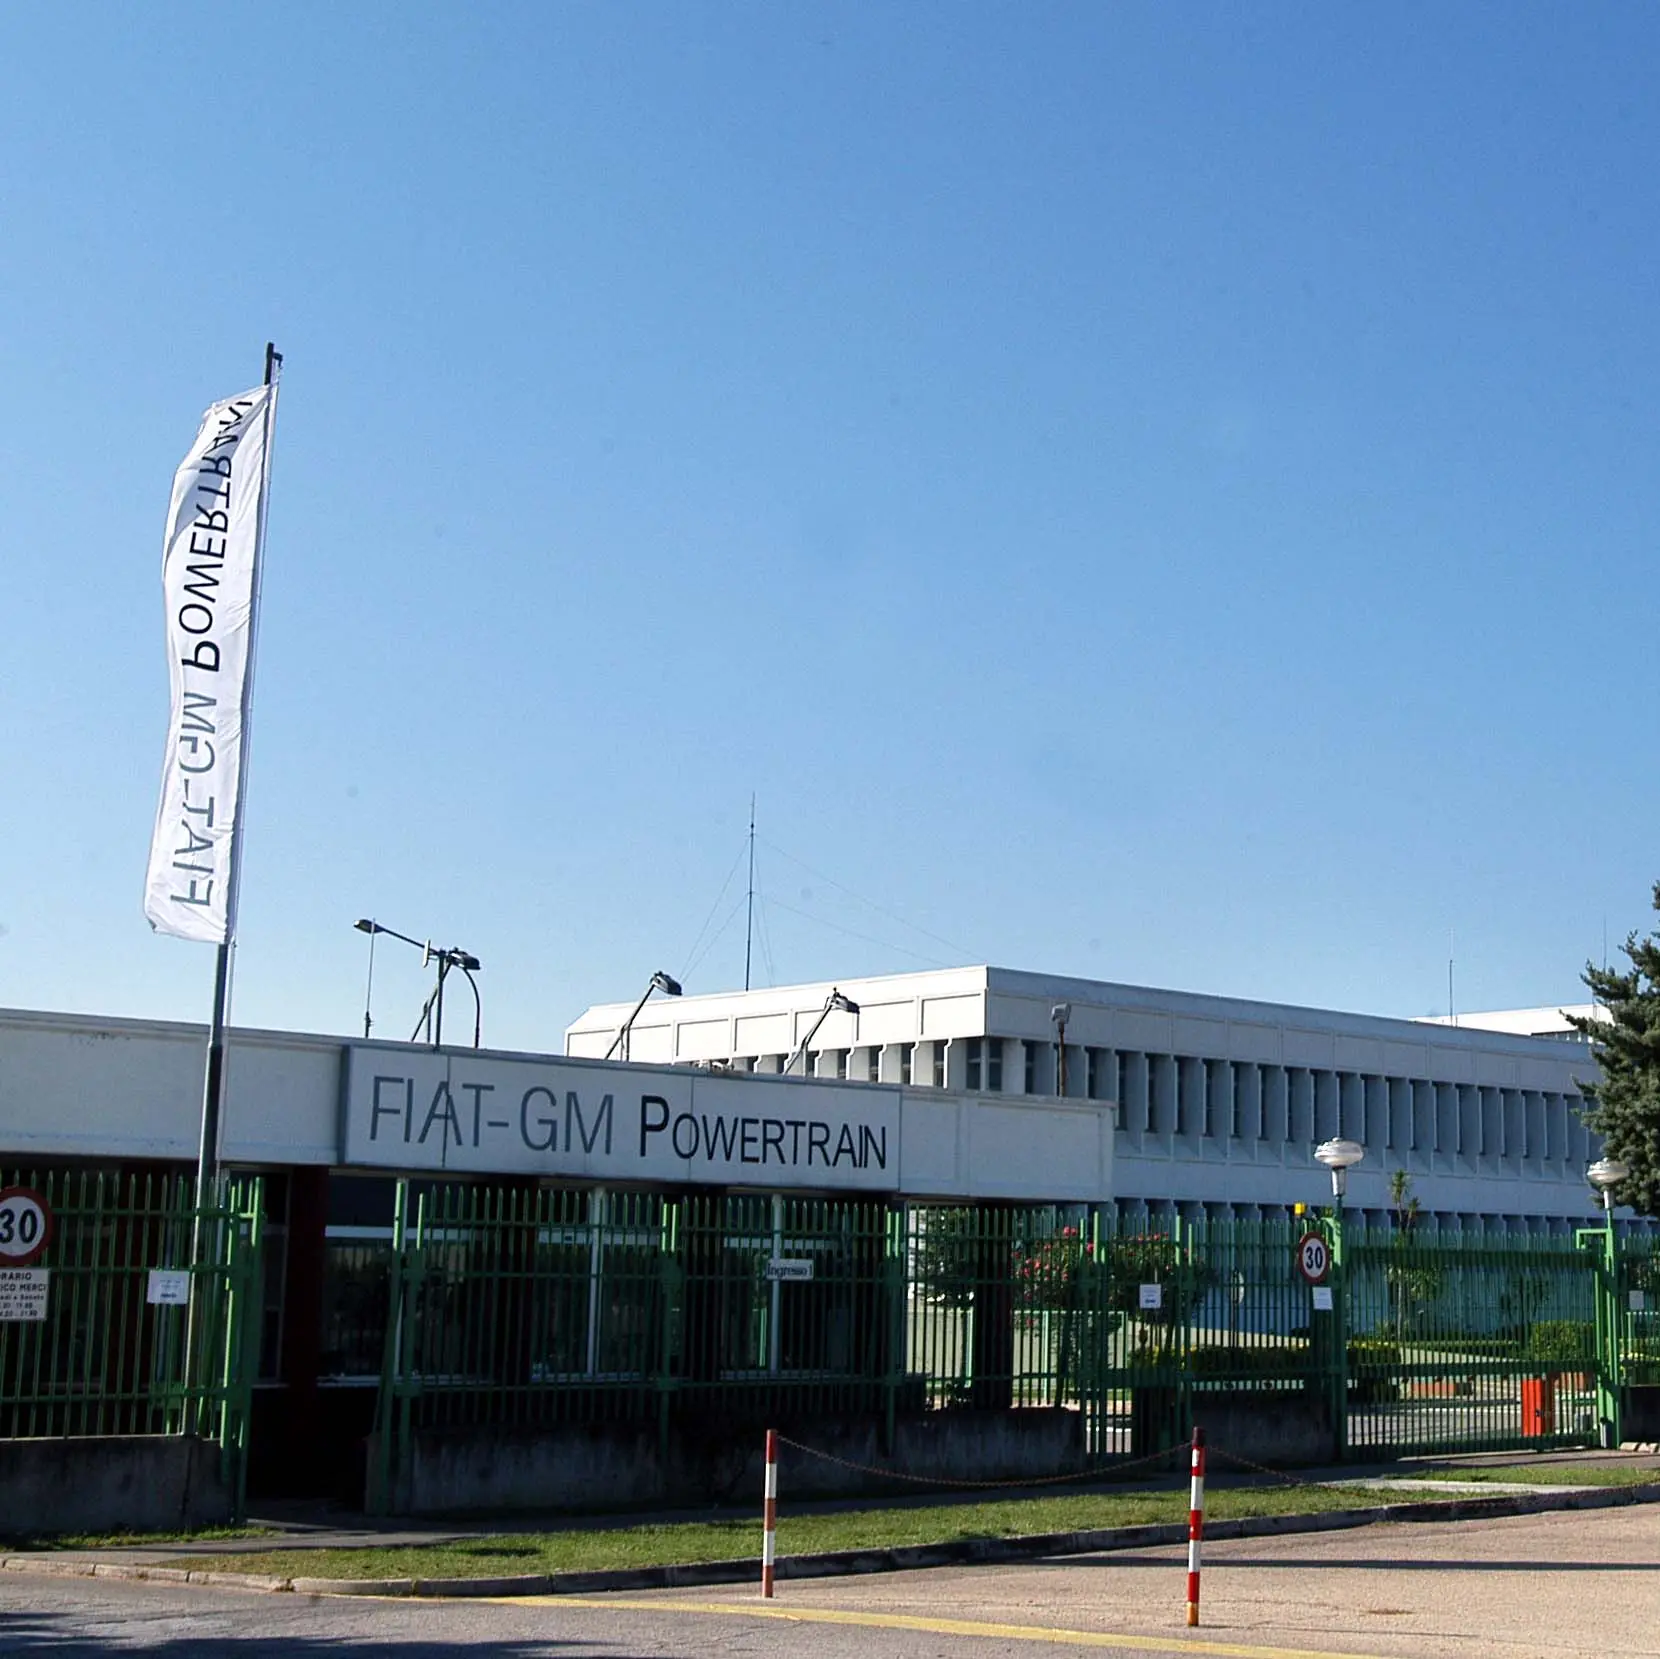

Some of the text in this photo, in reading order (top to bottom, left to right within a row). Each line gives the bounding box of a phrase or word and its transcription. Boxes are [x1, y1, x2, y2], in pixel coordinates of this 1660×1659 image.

[369, 1076, 887, 1170] FIAT-GM POWERTRAIN
[0, 1208, 38, 1244] 30
[1305, 1246, 1323, 1269] 30
[0, 1272, 32, 1281] RARIO
